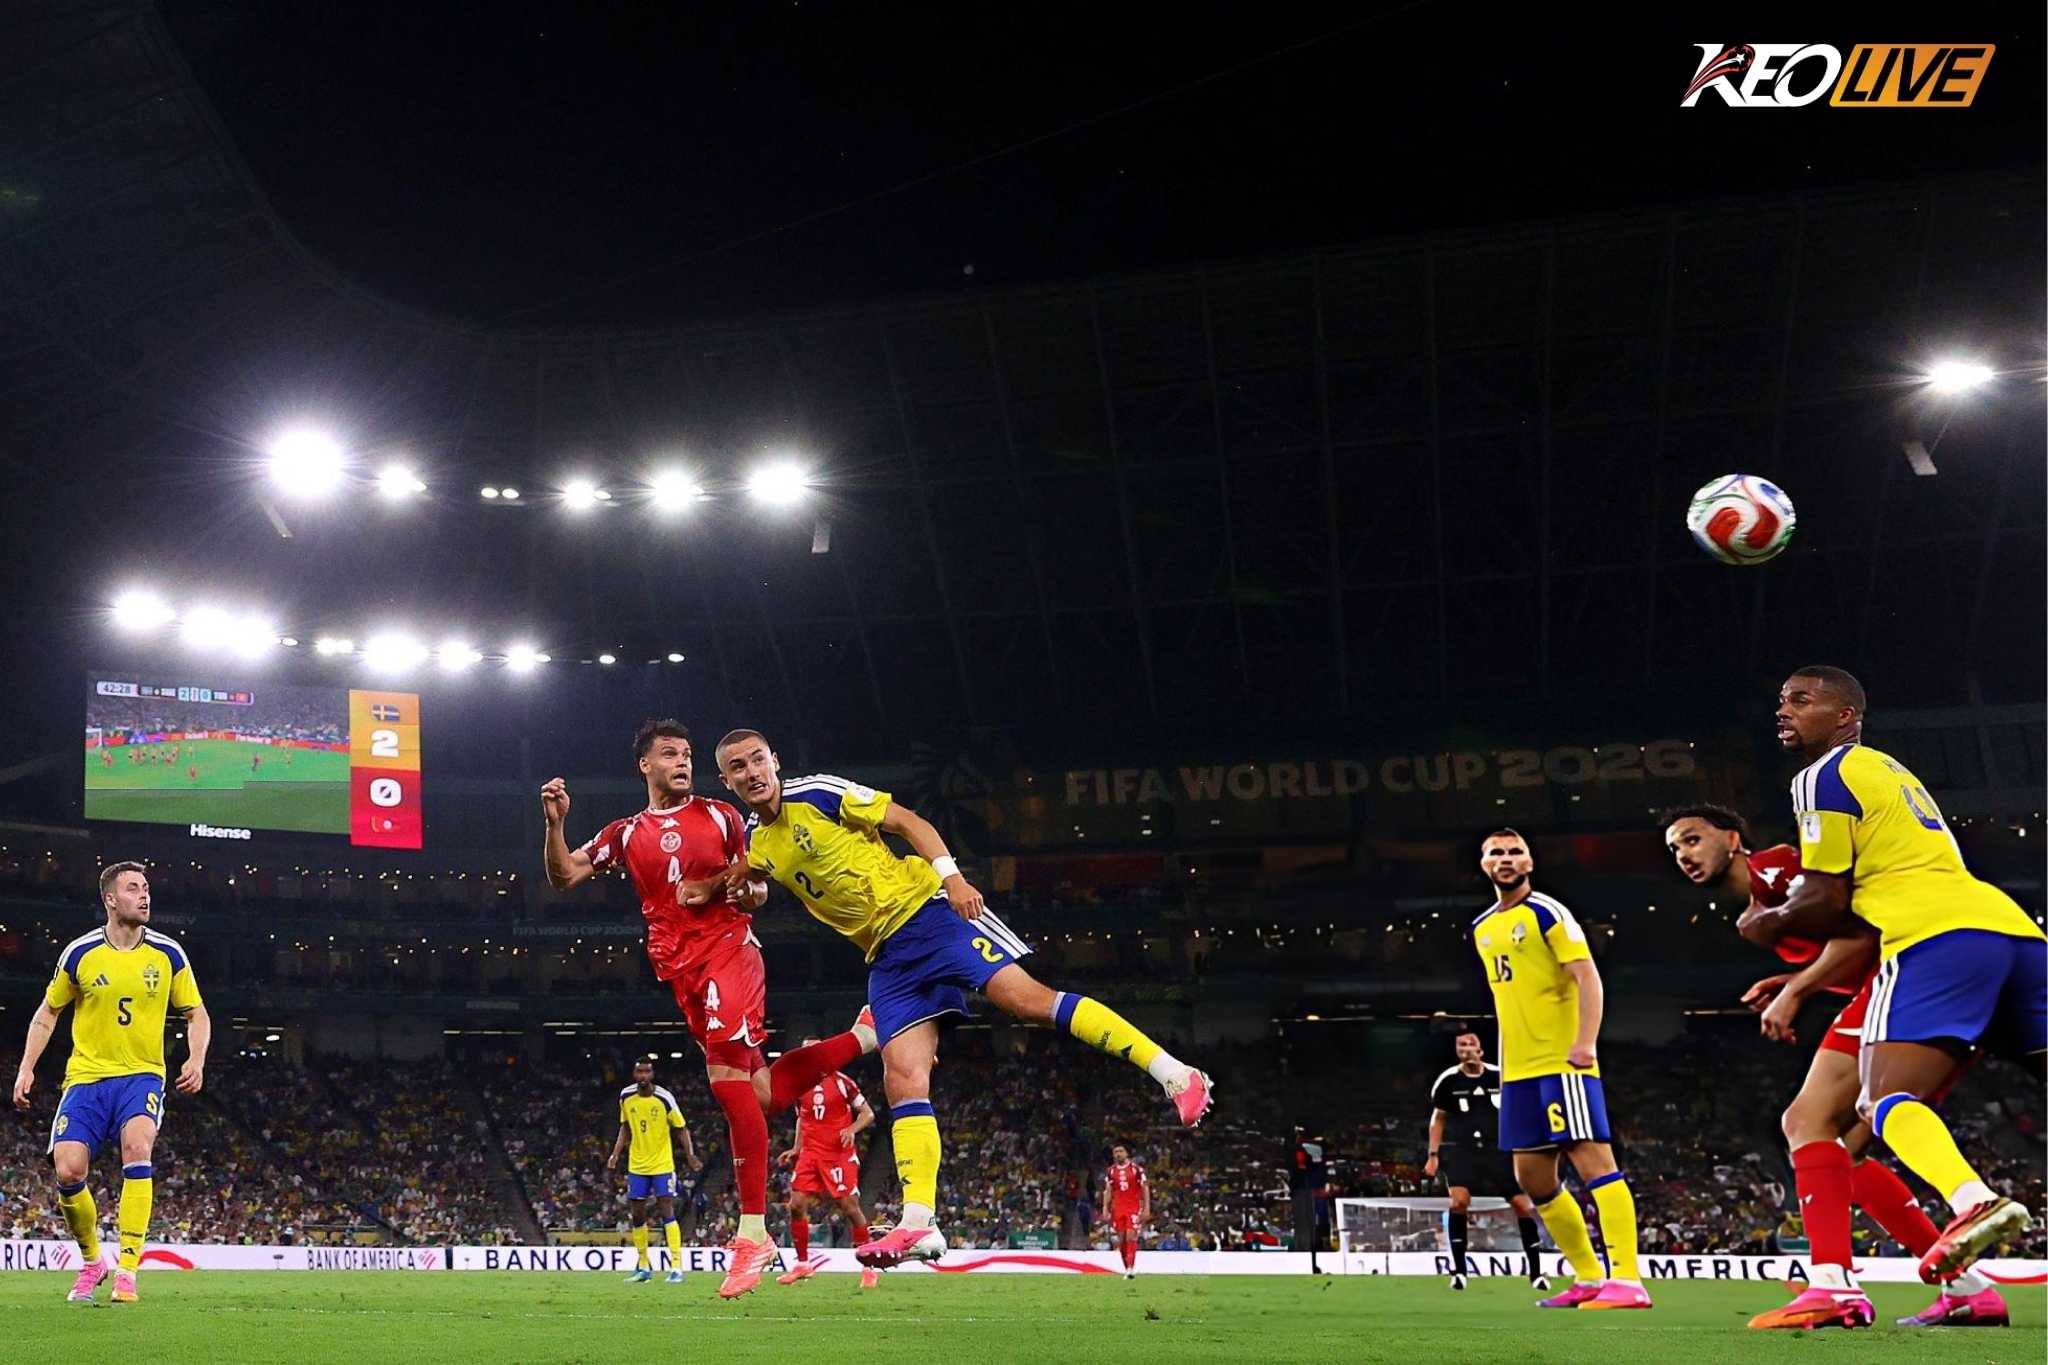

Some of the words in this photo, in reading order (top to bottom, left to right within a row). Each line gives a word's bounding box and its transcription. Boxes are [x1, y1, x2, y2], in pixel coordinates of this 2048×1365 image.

[371, 729, 399, 758] 2
[1064, 768, 1168, 805] FIFA
[1177, 760, 1369, 801] WORLD
[1381, 752, 1488, 792] CUP
[1496, 738, 1696, 790] 2026
[370, 777, 402, 807] 0
[190, 823, 251, 839] Hisense
[667, 855, 683, 885] 4
[794, 871, 825, 900] 2
[971, 937, 1003, 963] 2
[706, 979, 720, 1011] 4
[117, 997, 133, 1026] 5
[813, 1104, 825, 1120] 17
[640, 1119, 647, 1133] 9
[830, 1167, 843, 1184] 17
[485, 1249, 573, 1271] BANK
[584, 1249, 624, 1271] OF
[1649, 1259, 1809, 1281] MERICA
